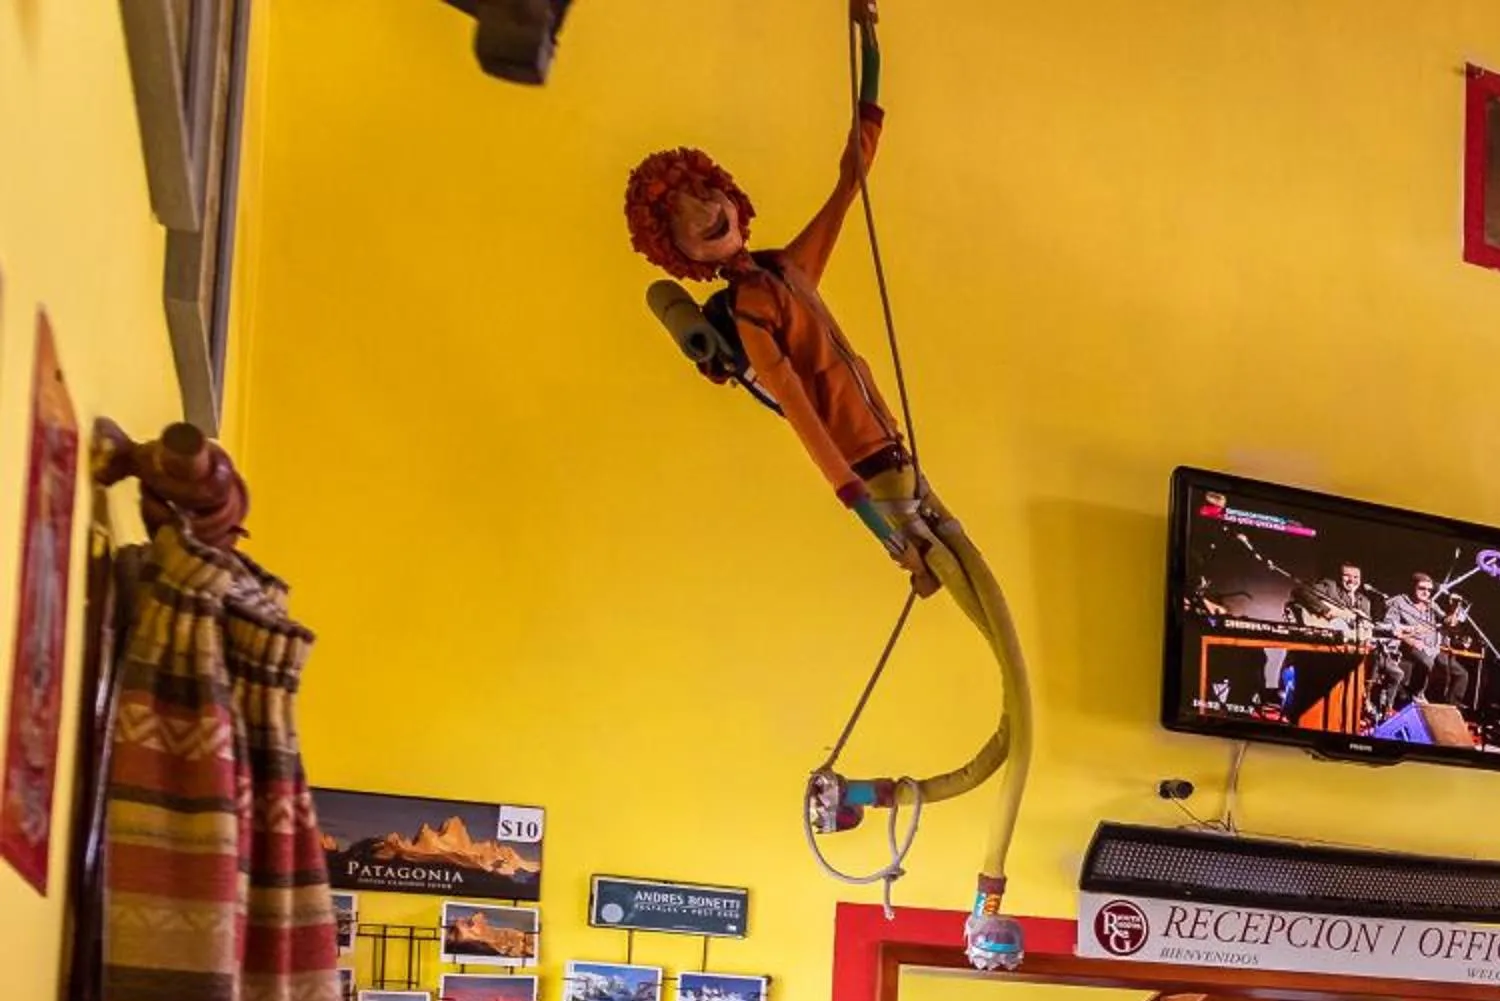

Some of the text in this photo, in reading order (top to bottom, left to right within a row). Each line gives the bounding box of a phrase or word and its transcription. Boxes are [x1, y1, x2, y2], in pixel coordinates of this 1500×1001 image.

[634, 891, 740, 909] ANDRES BONETTI
[1161, 905, 1384, 954] RECEPCION
[1159, 946, 1260, 966] BIENVENIDOS
